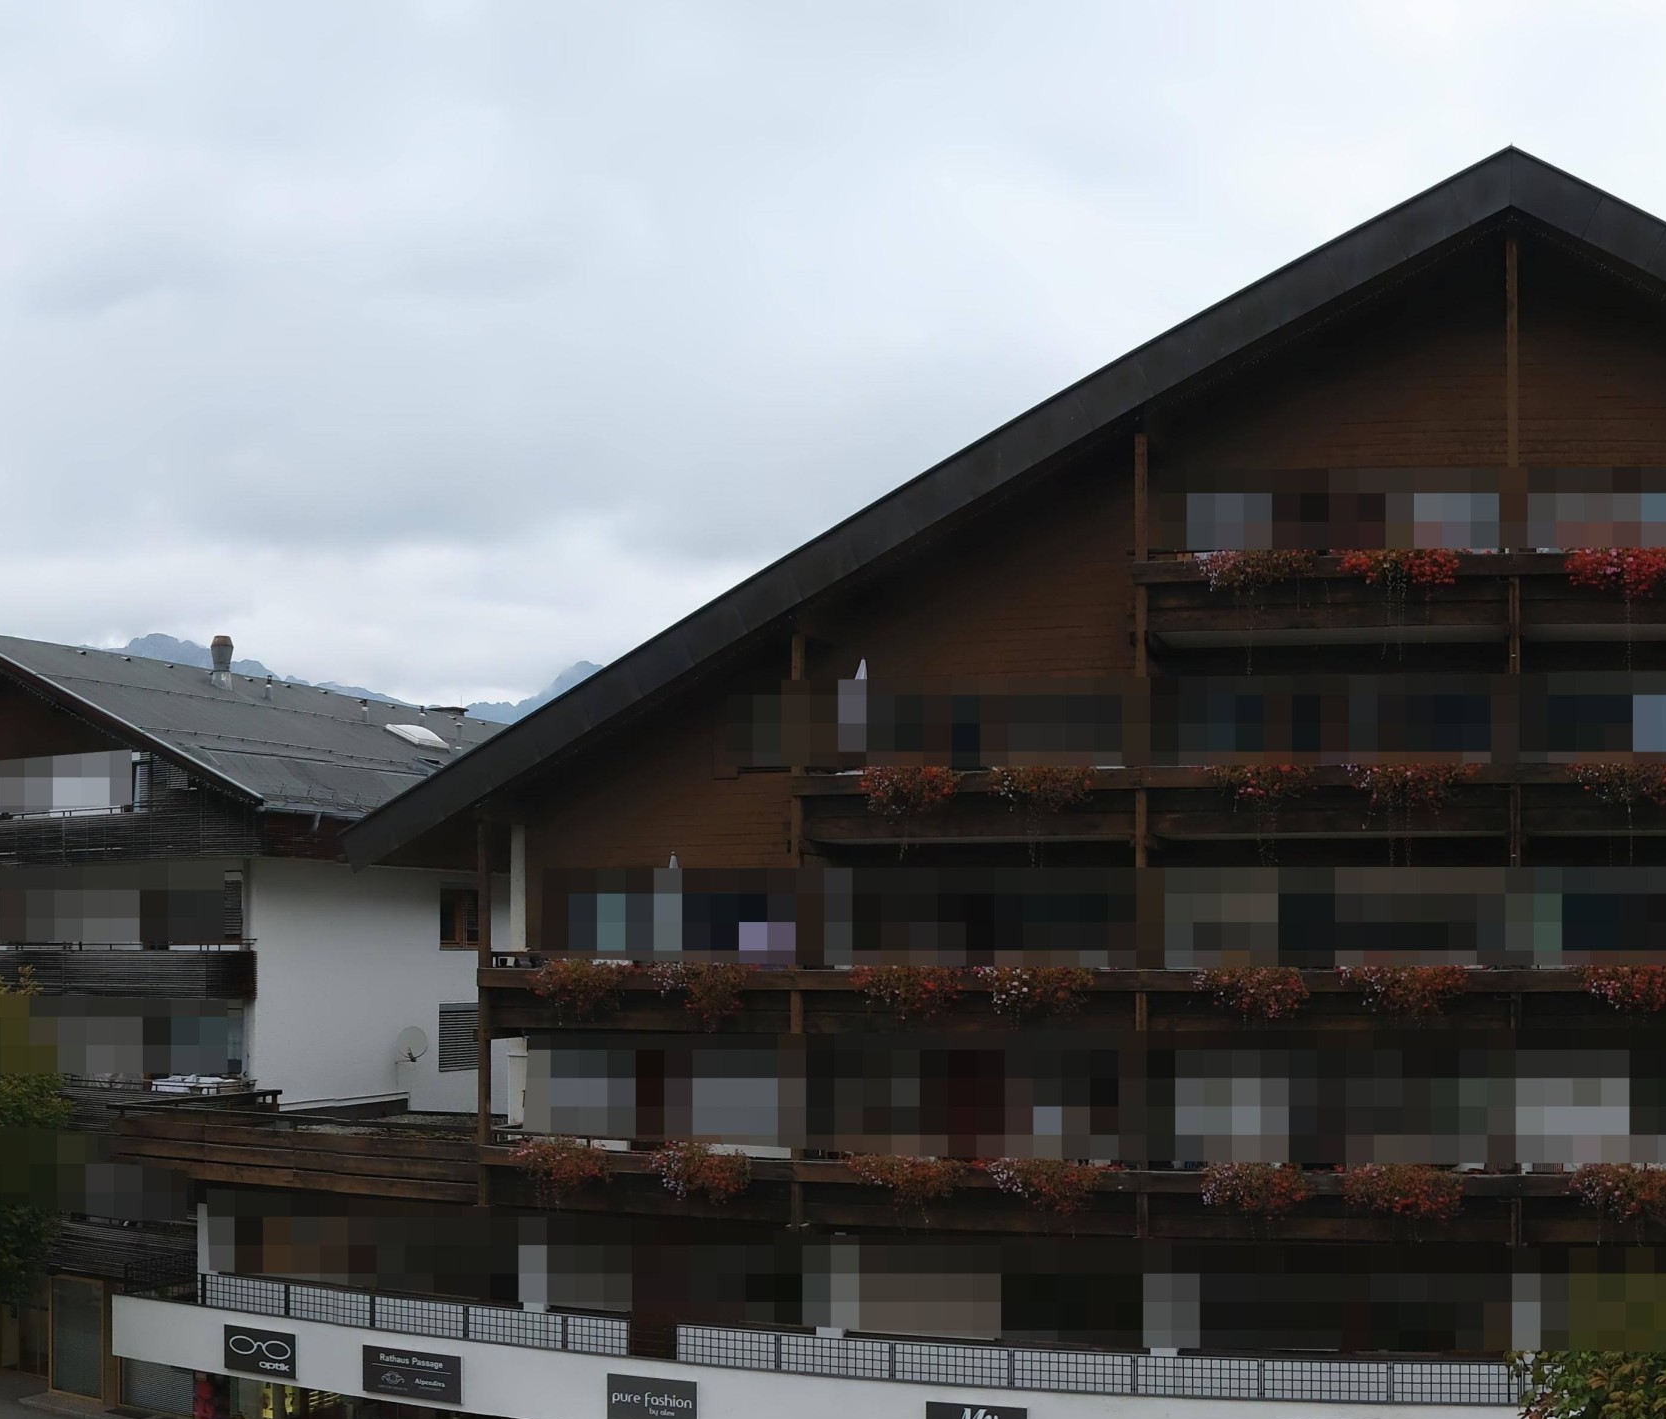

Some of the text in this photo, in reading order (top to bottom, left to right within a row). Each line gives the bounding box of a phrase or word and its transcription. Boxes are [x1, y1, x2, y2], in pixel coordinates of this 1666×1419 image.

[259, 1360, 290, 1372] optik
[379, 1353, 443, 1370] Rathaus Passage
[612, 1392, 692, 1409] pure fashion
[649, 1408, 658, 1416] by
